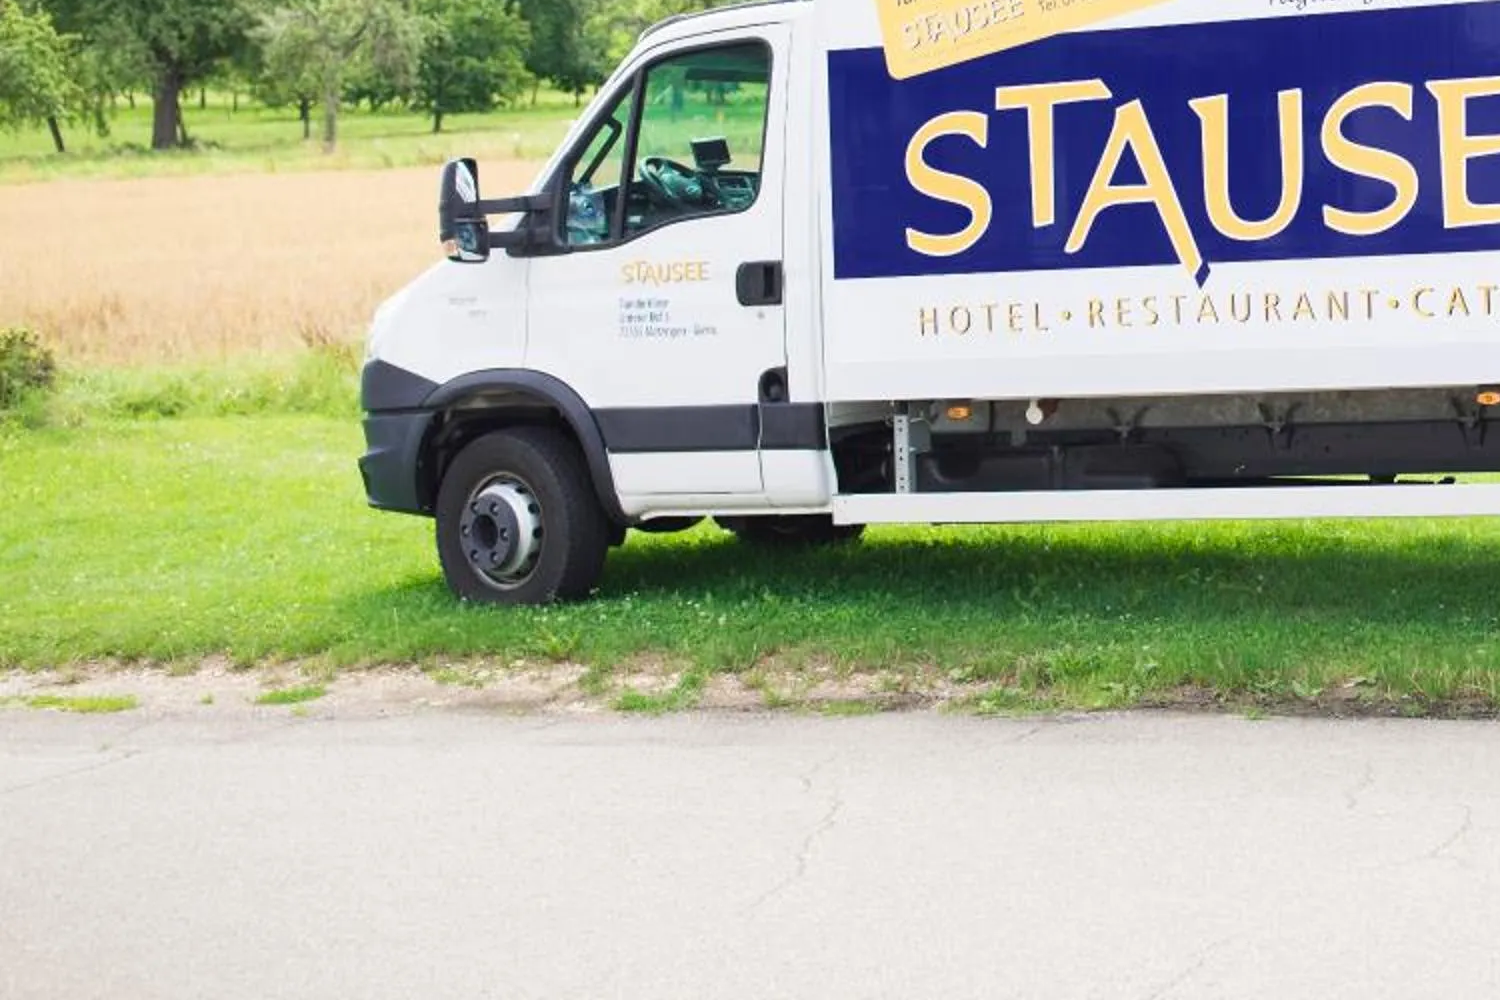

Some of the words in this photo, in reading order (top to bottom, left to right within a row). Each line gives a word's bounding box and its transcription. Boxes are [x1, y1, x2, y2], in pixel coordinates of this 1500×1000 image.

[621, 259, 711, 287] STAUSEE
[918, 300, 1052, 337] HOTEL
[1088, 288, 1380, 330] RESTAURANT
